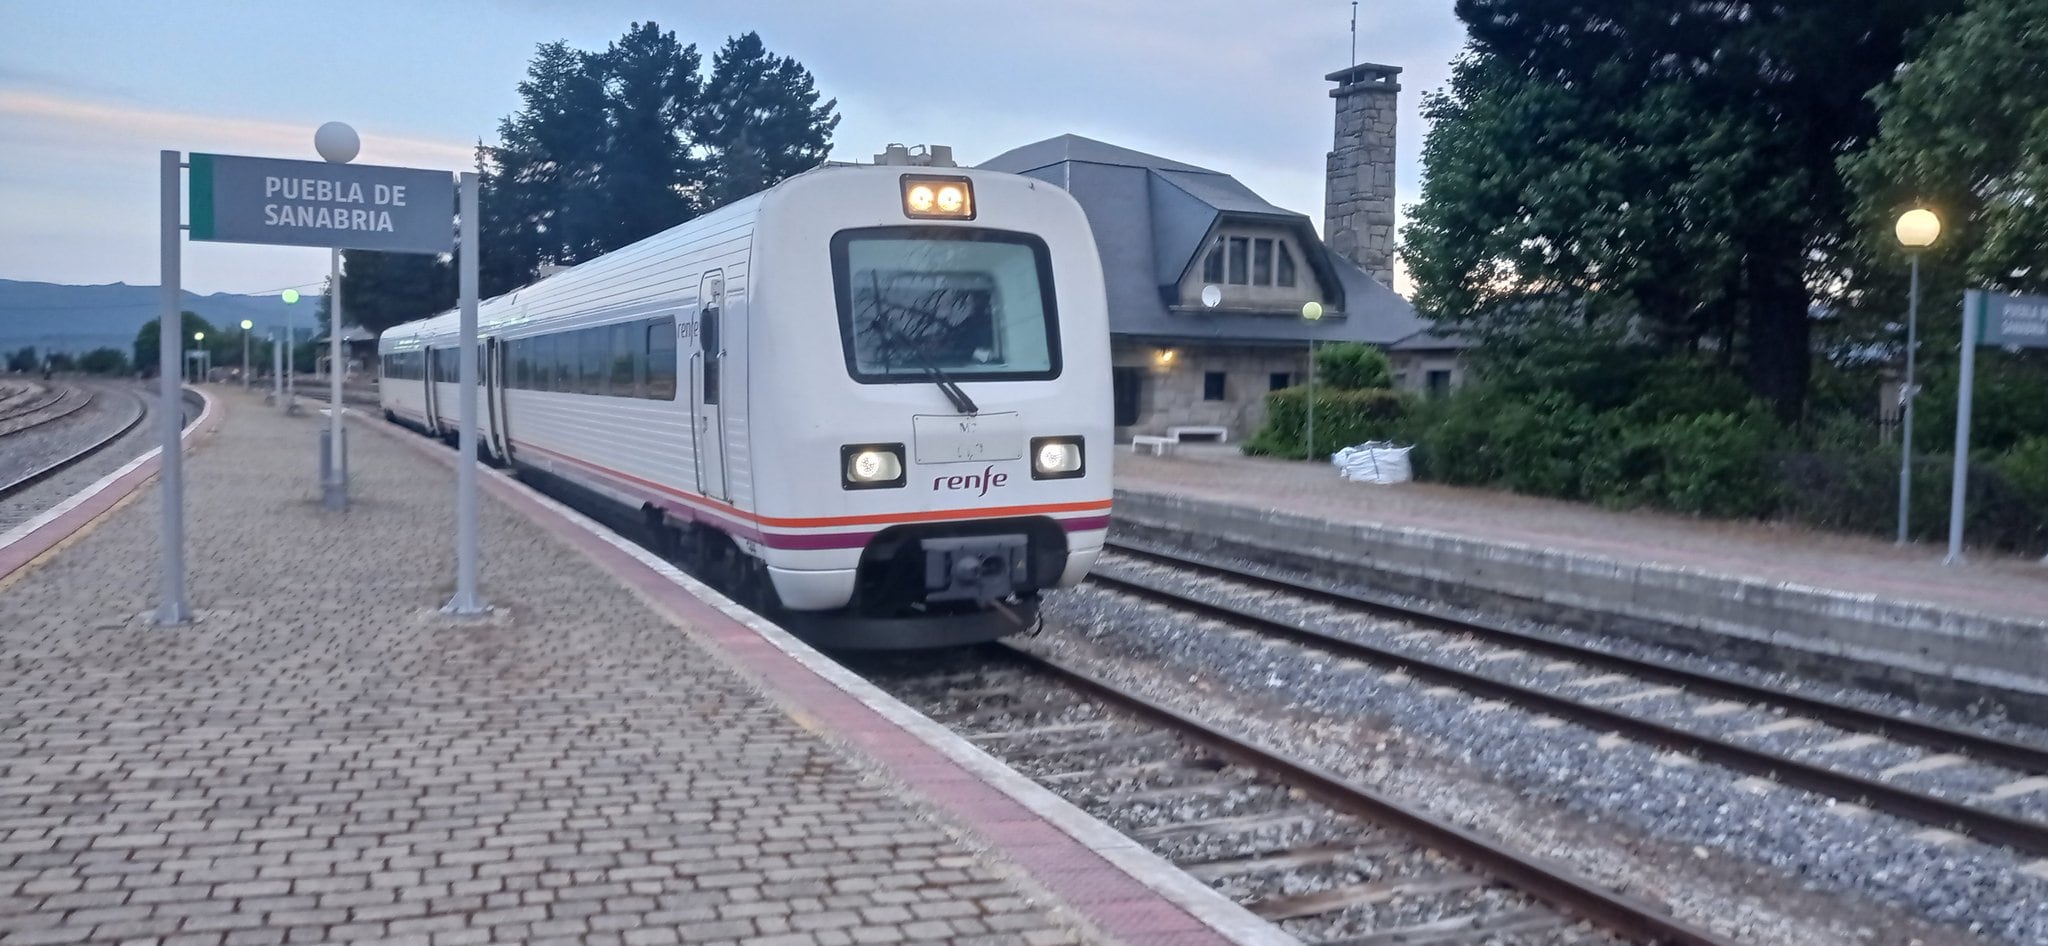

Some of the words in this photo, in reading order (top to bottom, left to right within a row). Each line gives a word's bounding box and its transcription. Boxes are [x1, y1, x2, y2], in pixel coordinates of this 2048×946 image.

[265, 176, 364, 204] PUEBLA
[374, 183, 407, 207] DE
[264, 203, 394, 232] SANABRIA
[677, 310, 699, 348] renfe
[933, 465, 1008, 498] renfe
